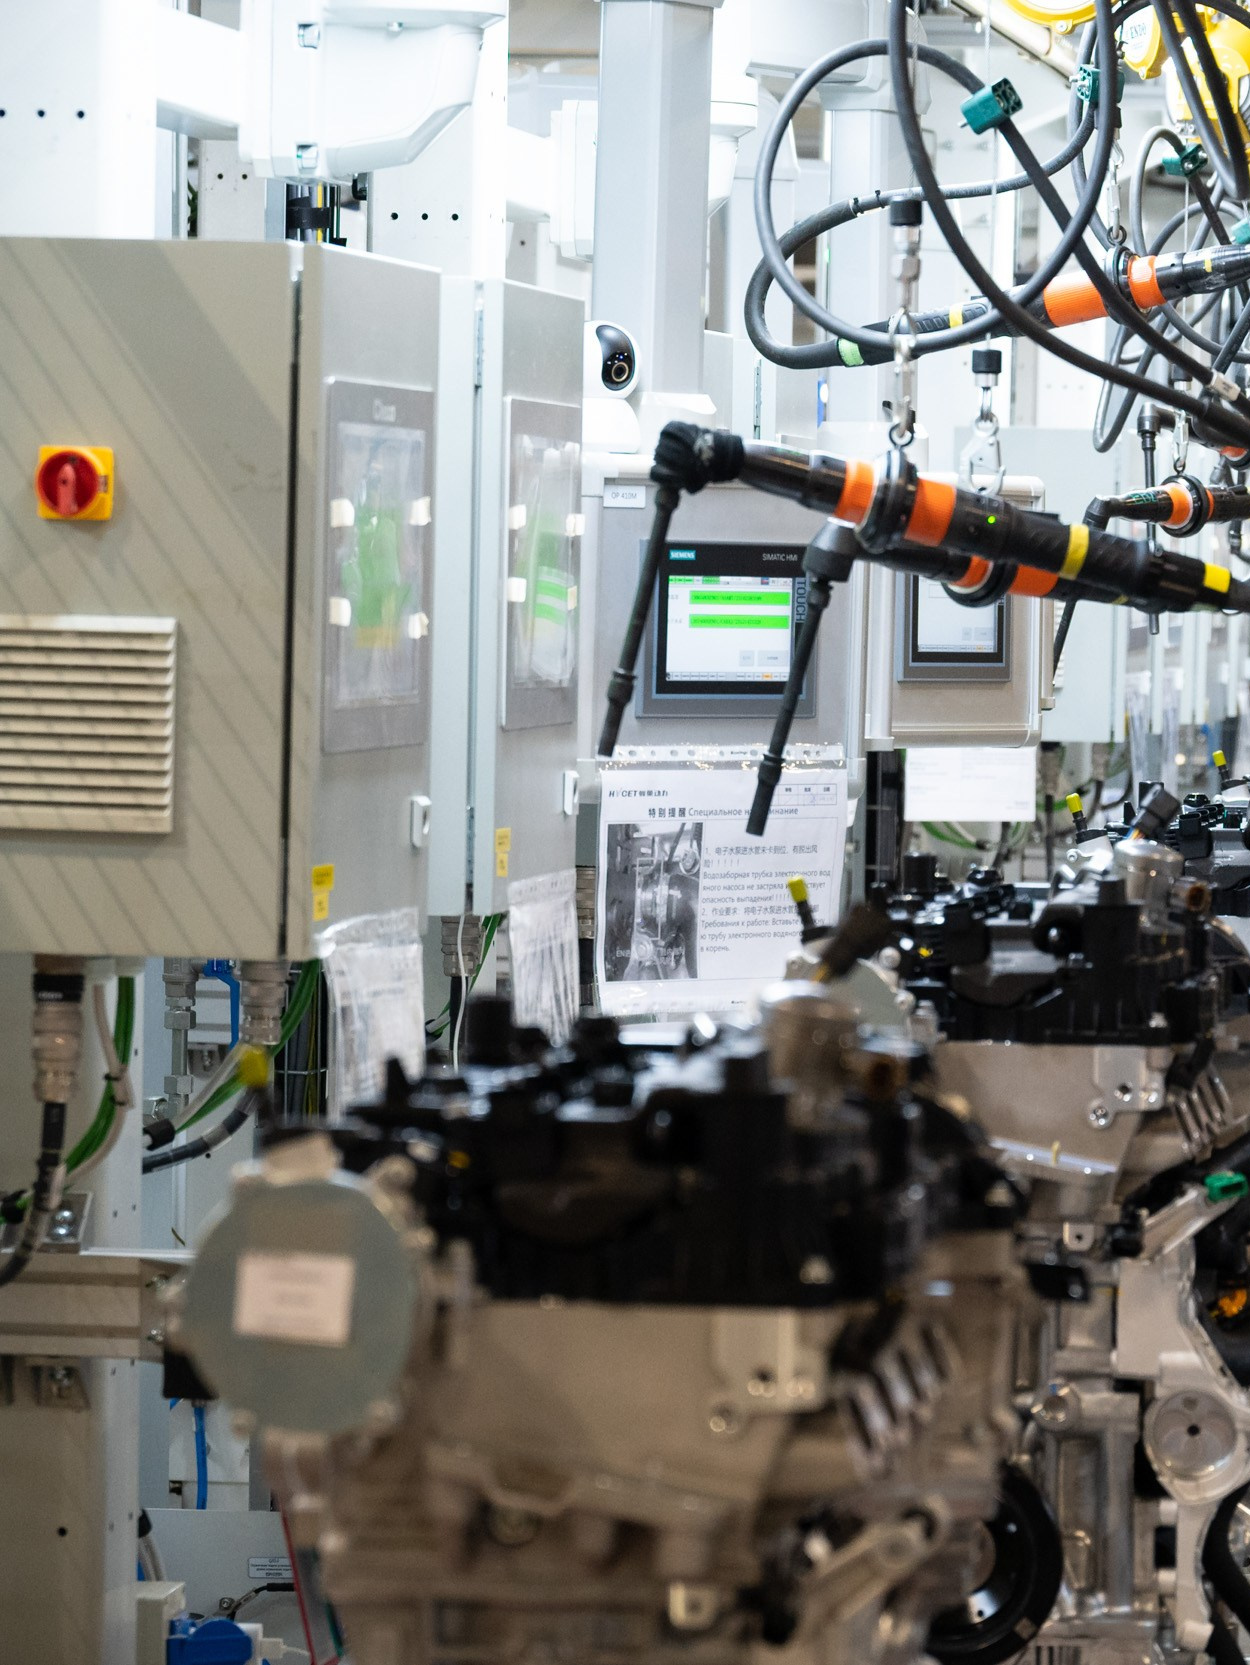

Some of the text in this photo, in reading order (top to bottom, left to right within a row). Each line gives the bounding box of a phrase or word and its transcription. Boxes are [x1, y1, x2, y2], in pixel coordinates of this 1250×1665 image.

[670, 551, 695, 559] SIEMENS
[762, 553, 798, 562] SIMATIC HMI
[795, 579, 806, 623] TOUCH
[688, 807, 742, 818] Специальное
